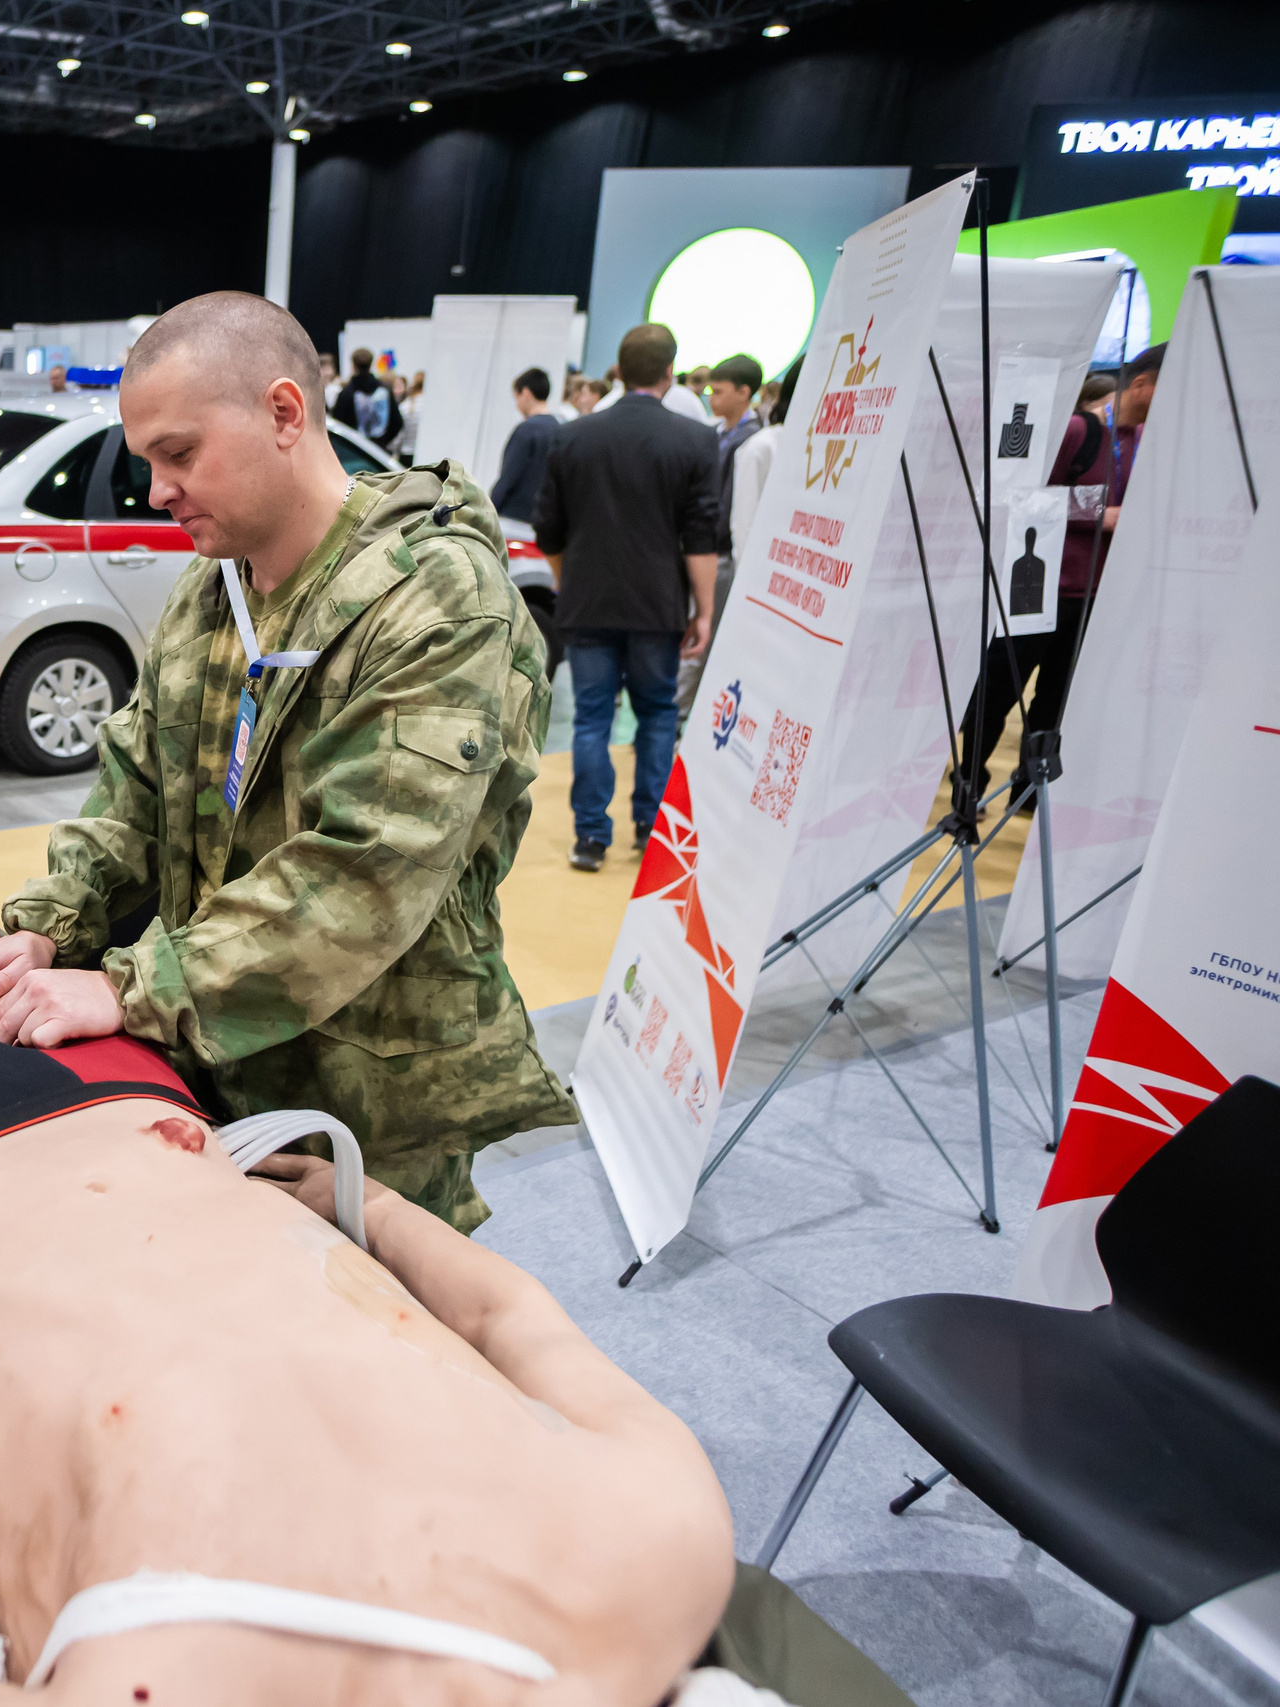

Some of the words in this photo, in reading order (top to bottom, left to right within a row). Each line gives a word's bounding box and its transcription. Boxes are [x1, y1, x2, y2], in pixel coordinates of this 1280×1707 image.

[1058, 119, 1155, 154] ТВОЯ
[1154, 114, 1280, 151] КАРЬЕ
[1189, 966, 1280, 1003] электроник
[1210, 951, 1264, 977] ГБПОУ
[1266, 969, 1280, 985] Н
